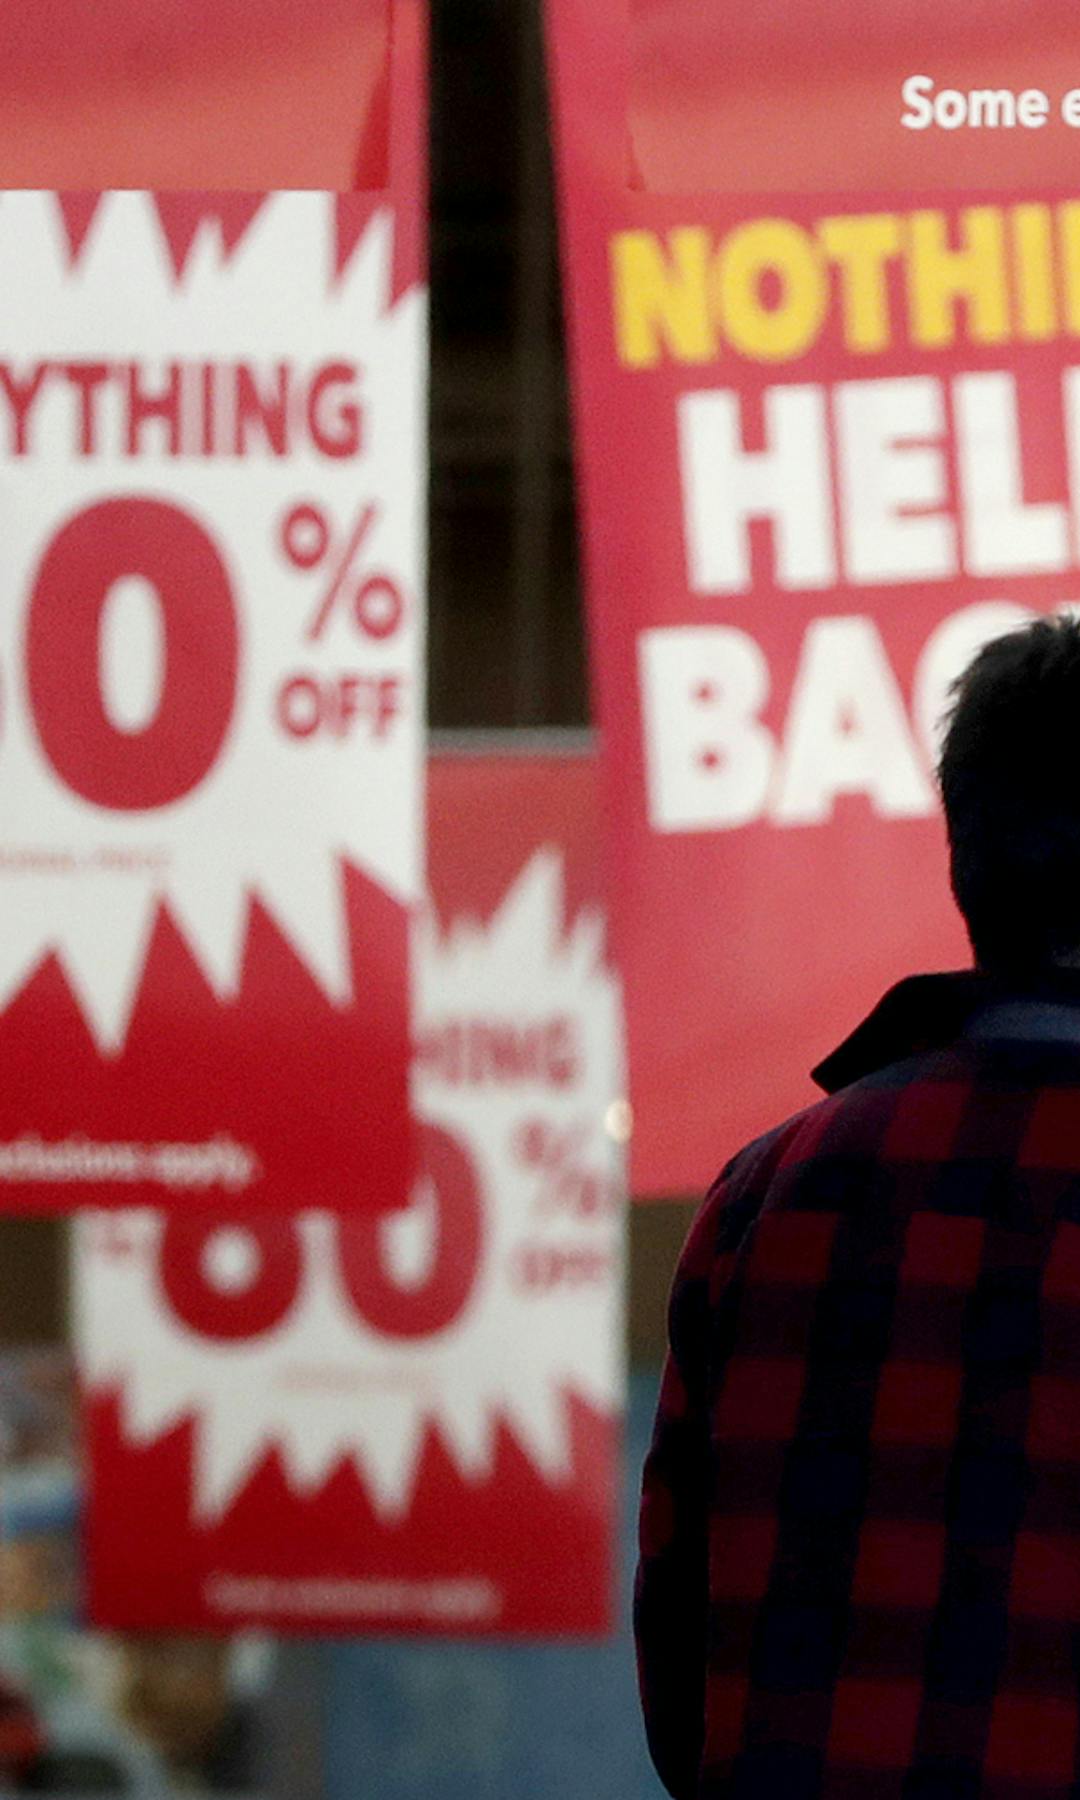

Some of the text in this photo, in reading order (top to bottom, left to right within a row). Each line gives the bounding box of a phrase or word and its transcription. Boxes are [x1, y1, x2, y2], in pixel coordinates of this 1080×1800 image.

[900, 75, 1049, 129] Some
[280, 499, 404, 641] %
[279, 673, 401, 740] OFF
